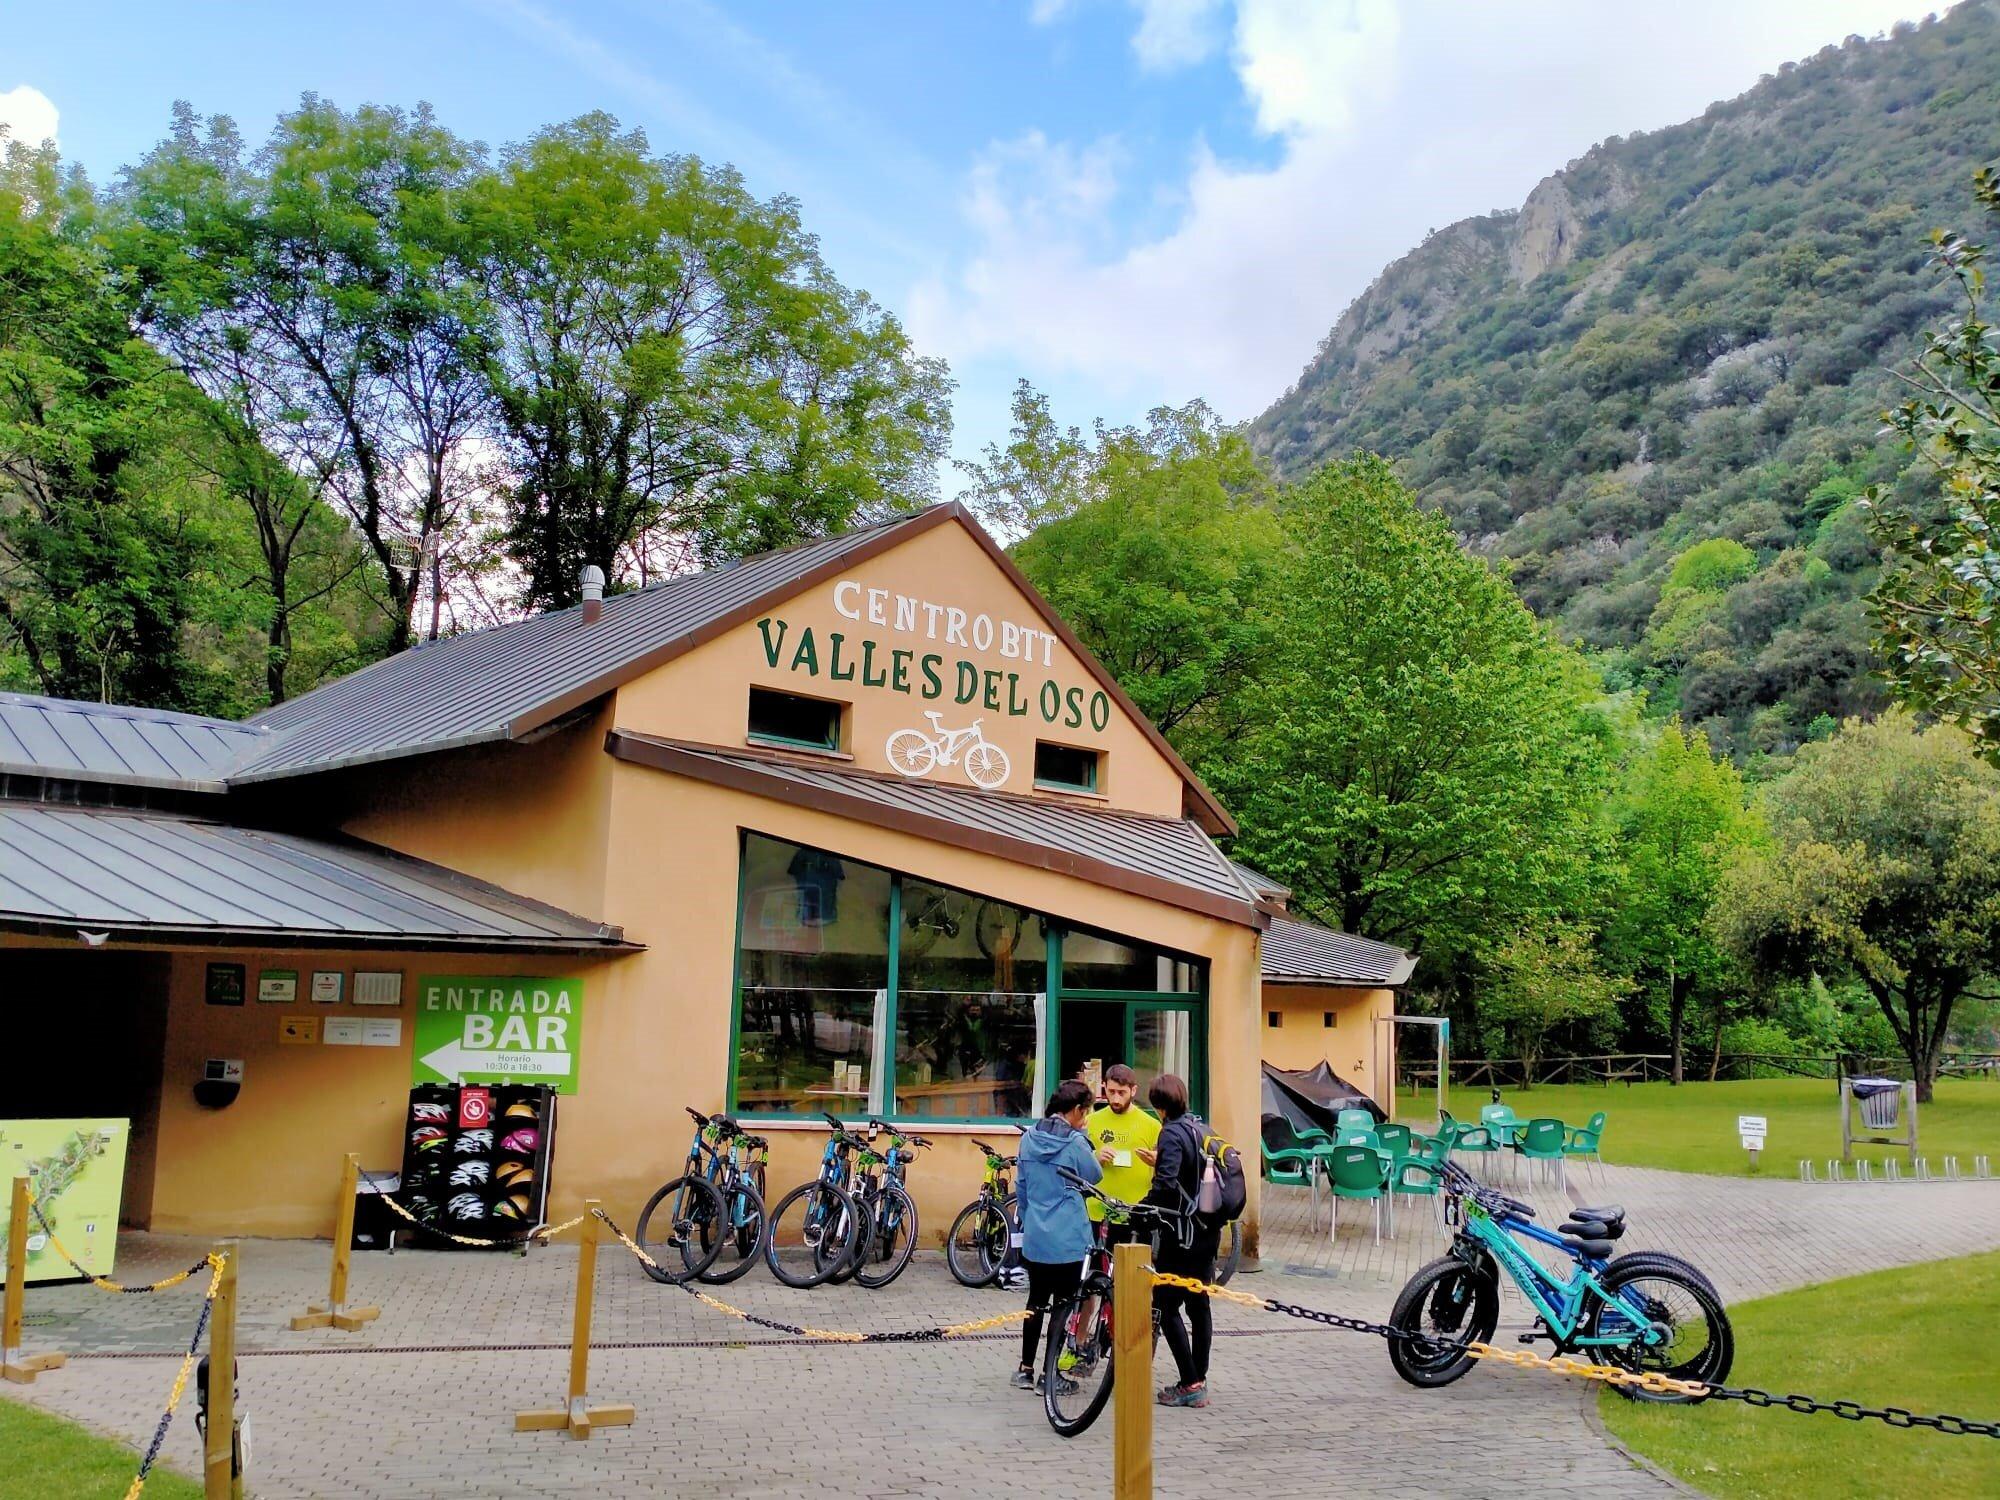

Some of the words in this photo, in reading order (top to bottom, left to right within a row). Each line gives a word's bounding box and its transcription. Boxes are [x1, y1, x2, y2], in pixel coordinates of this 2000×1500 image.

[834, 580, 994, 651] CENTRO
[1000, 620, 1058, 667] BTT
[757, 618, 943, 699] VALLES
[955, 660, 1029, 717] DEL
[1039, 679, 1110, 732] OSO
[426, 987, 572, 1014] ENTRADA
[463, 1014, 568, 1050] BAR
[485, 1062, 509, 1071] 10:30
[510, 1063, 516, 1071] a
[518, 1063, 542, 1072] 18:30
[497, 1053, 531, 1063] Horario
